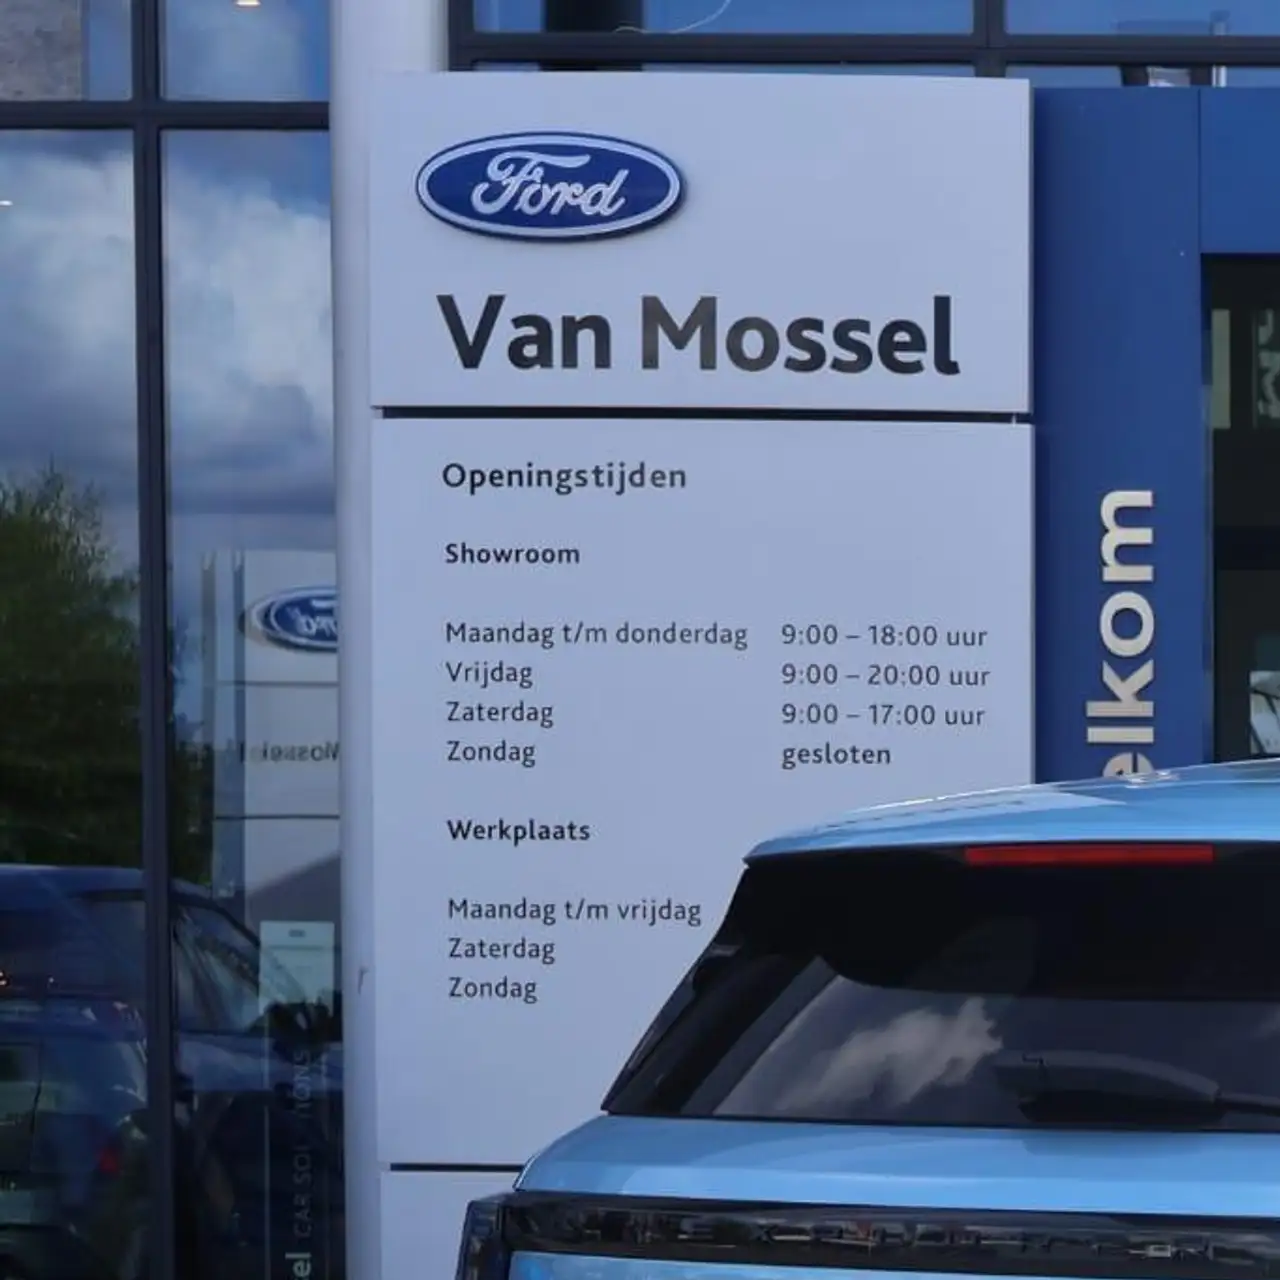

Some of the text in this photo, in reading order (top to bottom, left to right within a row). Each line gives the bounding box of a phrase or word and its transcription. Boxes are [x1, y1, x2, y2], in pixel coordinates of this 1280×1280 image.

[470, 150, 628, 219] Ford
[436, 294, 961, 376] Van Mossel
[442, 462, 686, 496] Openingstijden
[445, 542, 580, 565] Showroom
[446, 621, 748, 651] Maandag t/m donderdag
[781, 623, 838, 646] 9:00
[868, 624, 938, 647] 18:00
[946, 630, 988, 648] uur
[1086, 489, 1154, 778] lkom
[445, 661, 533, 689] Vrijdag
[781, 663, 838, 685] 9:00
[867, 664, 941, 686] 20:00
[949, 670, 991, 688] uur
[446, 700, 554, 729] Zaterdag
[781, 703, 838, 725] 9:00
[869, 704, 936, 726] 17:00
[944, 710, 985, 728] uur
[446, 739, 536, 768] Zondag
[781, 742, 892, 771] gesloten
[447, 819, 591, 847] Werkplaats
[447, 897, 702, 927] Maandag t/m vrijdag
[448, 937, 556, 965] Zaterdag
[448, 975, 538, 1005] Zondag
